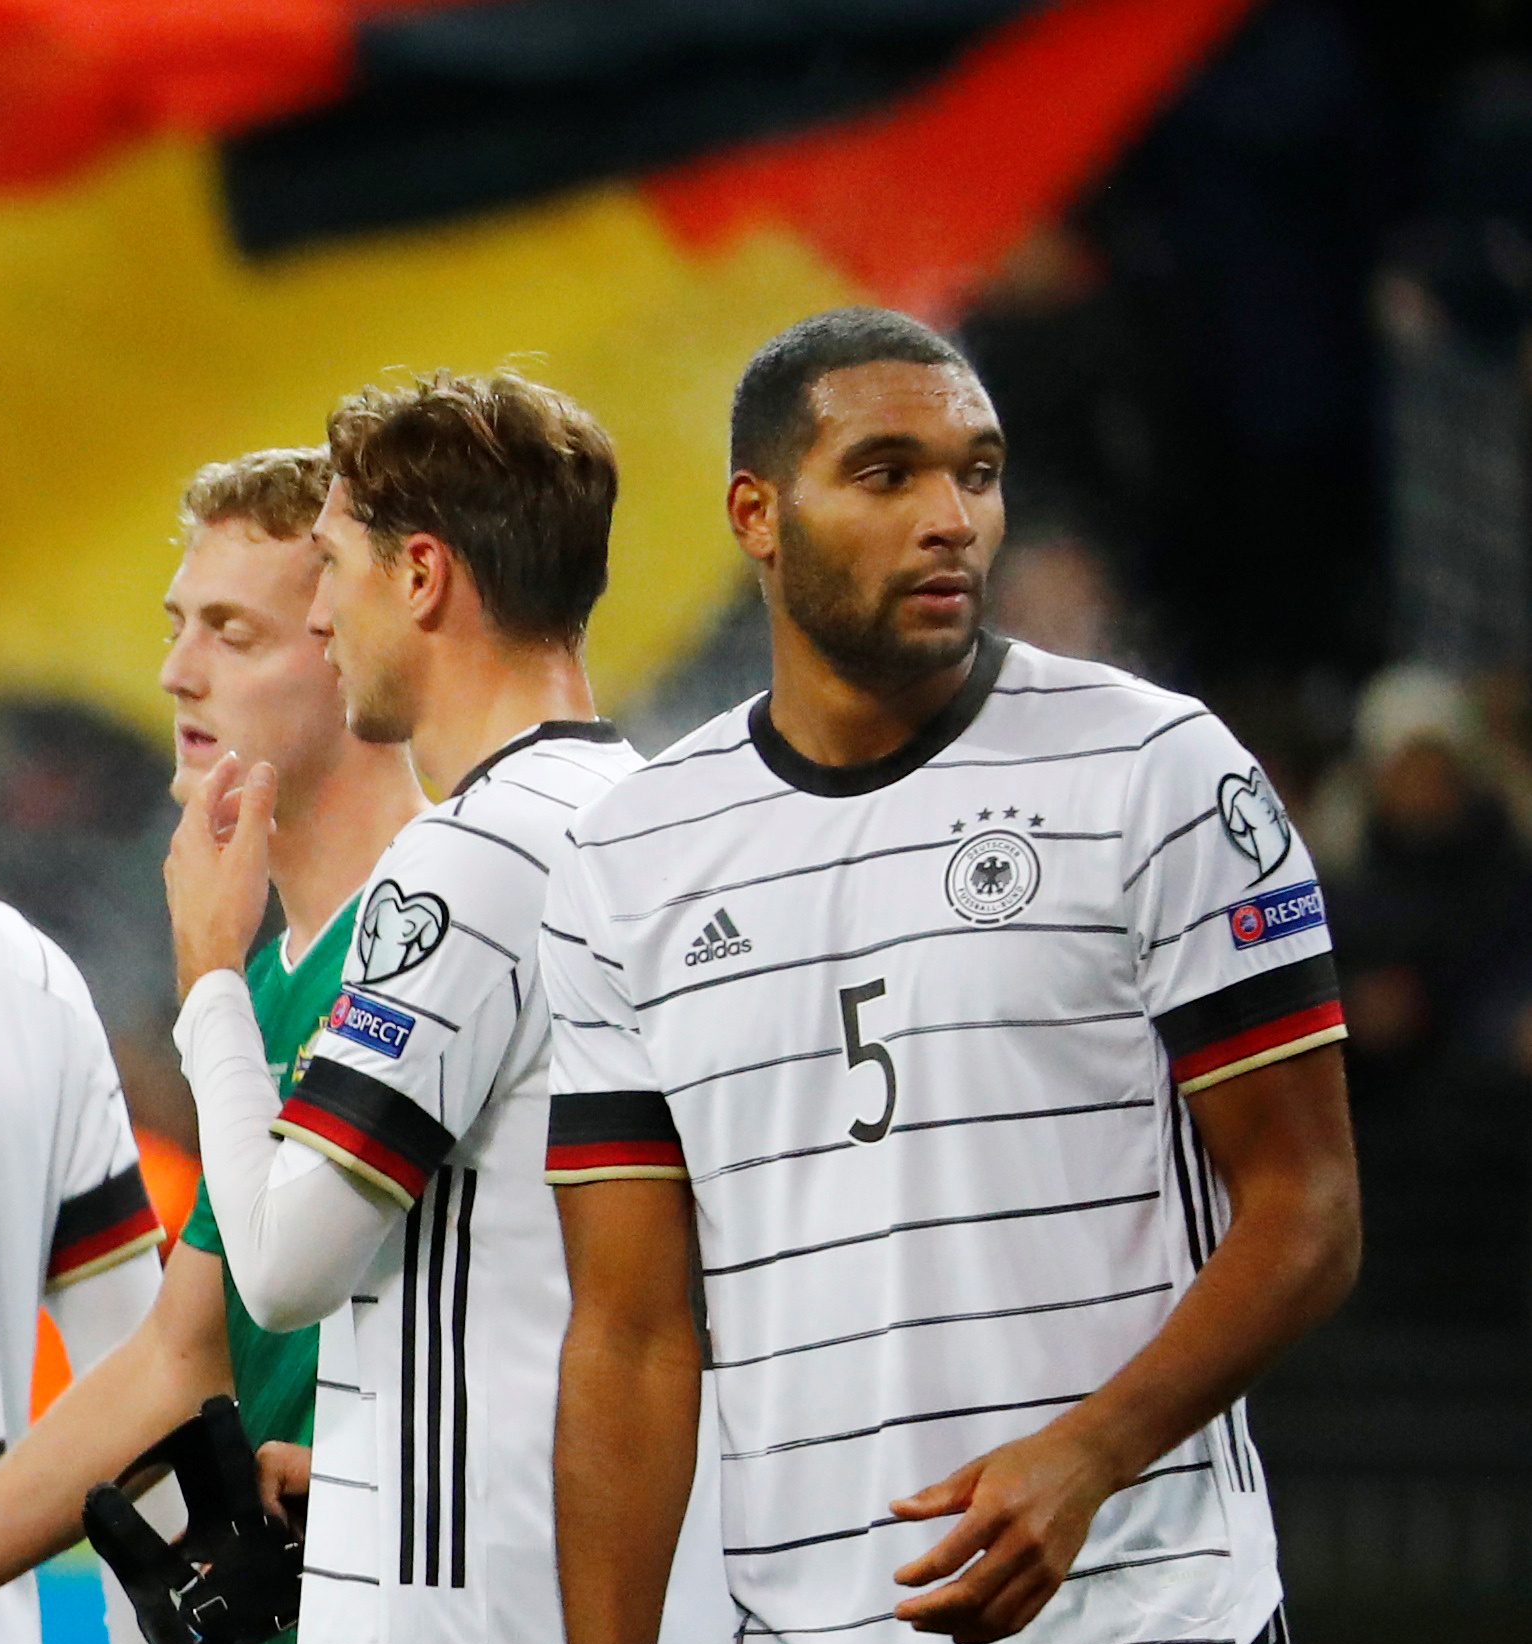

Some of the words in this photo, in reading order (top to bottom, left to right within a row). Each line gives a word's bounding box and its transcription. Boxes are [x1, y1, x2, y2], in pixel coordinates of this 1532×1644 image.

[966, 841, 1022, 859] DEUTSCHER
[685, 939, 752, 967] adidas
[838, 978, 897, 1143] 5
